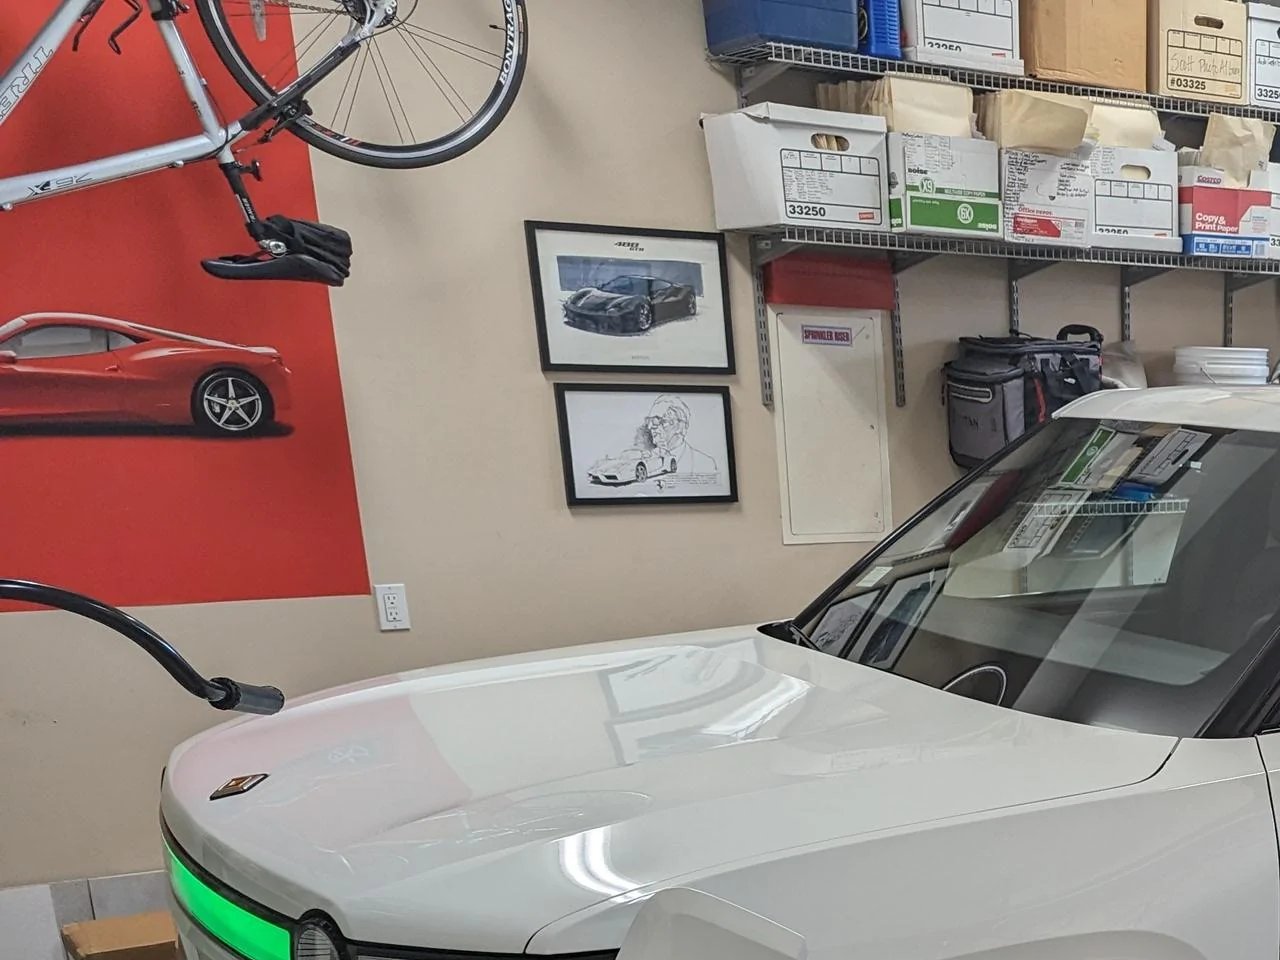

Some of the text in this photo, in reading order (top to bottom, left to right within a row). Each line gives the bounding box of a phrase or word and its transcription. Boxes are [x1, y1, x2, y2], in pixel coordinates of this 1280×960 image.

[0, 46, 53, 121] TRE
[1170, 78, 1206, 91] #03325
[788, 204, 826, 217] 33250
[1195, 222, 1217, 232] Print
